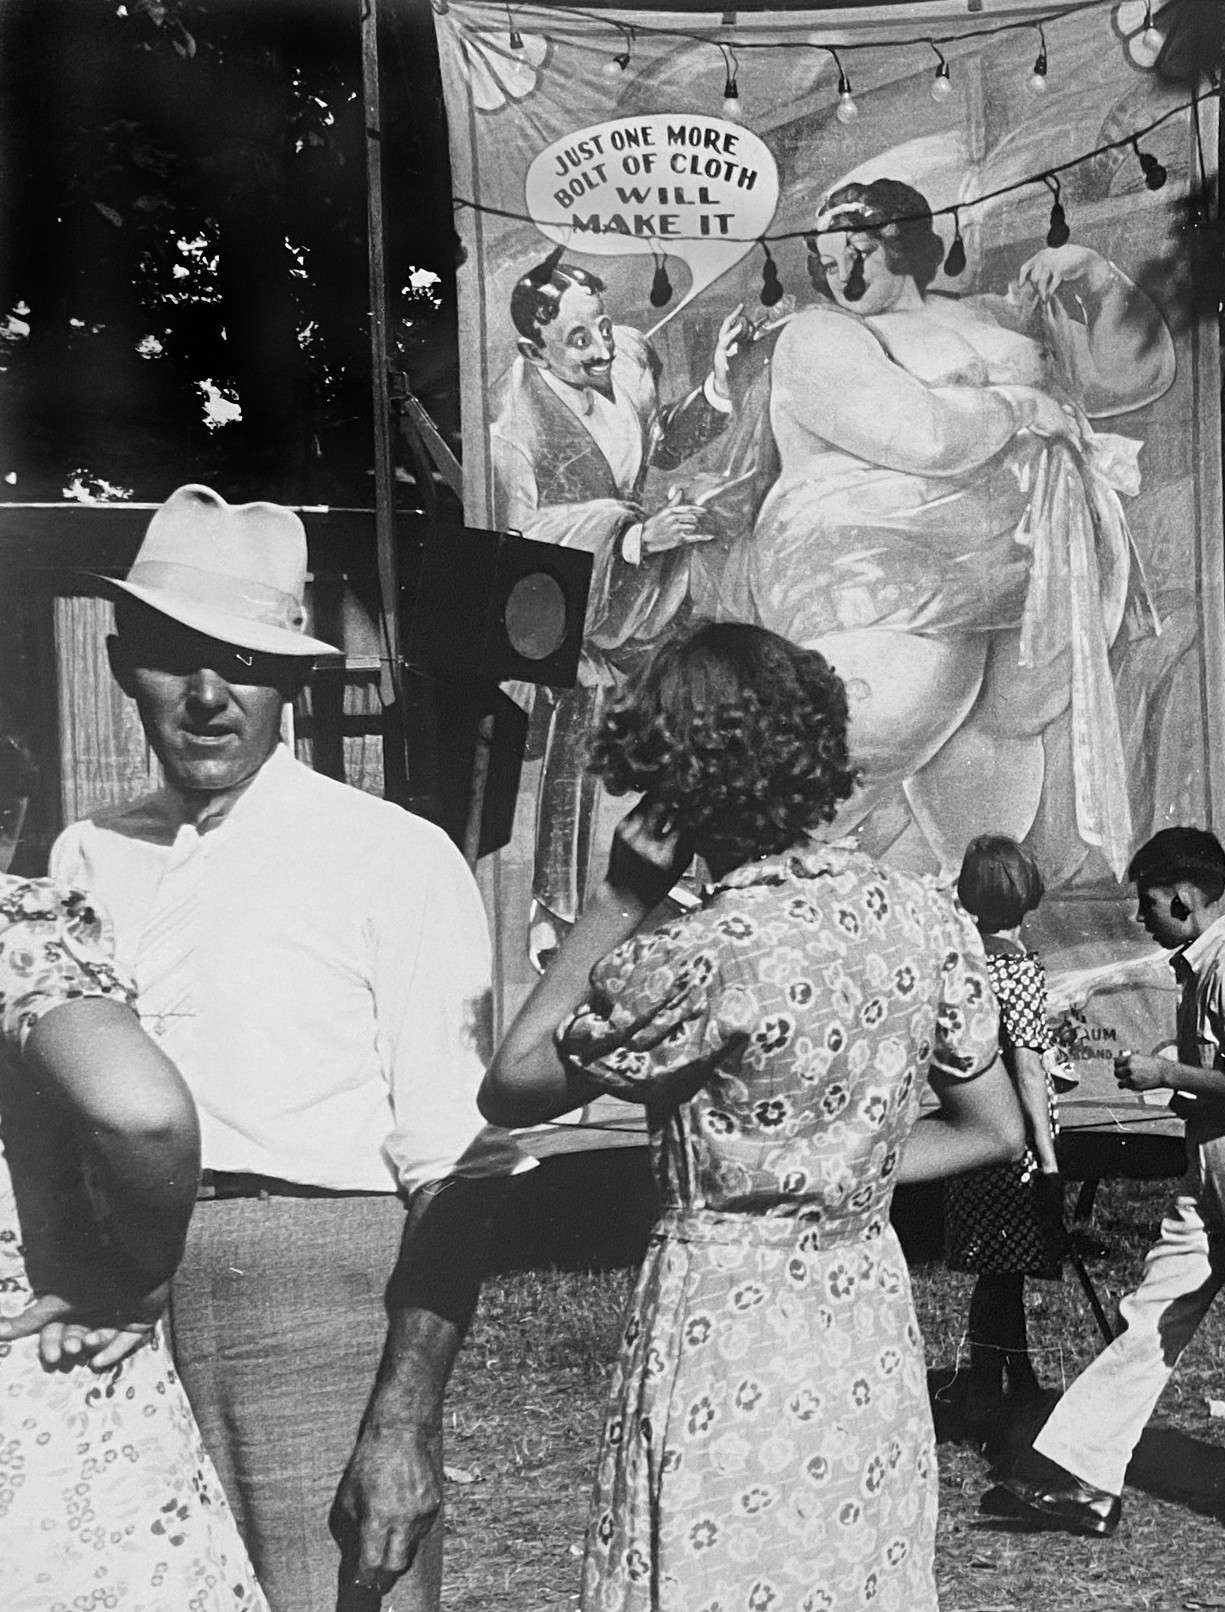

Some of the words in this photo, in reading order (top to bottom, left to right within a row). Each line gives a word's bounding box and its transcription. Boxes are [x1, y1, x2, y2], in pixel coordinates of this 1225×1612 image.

[555, 135, 603, 177] JUST
[610, 126, 656, 150] ONE
[666, 125, 739, 156] MORE
[553, 163, 608, 209] BOLT
[622, 153, 657, 175] OF
[669, 153, 758, 191] CLOTH
[616, 187, 720, 205] WILL
[571, 214, 682, 235] MAKE
[699, 214, 735, 235] IT
